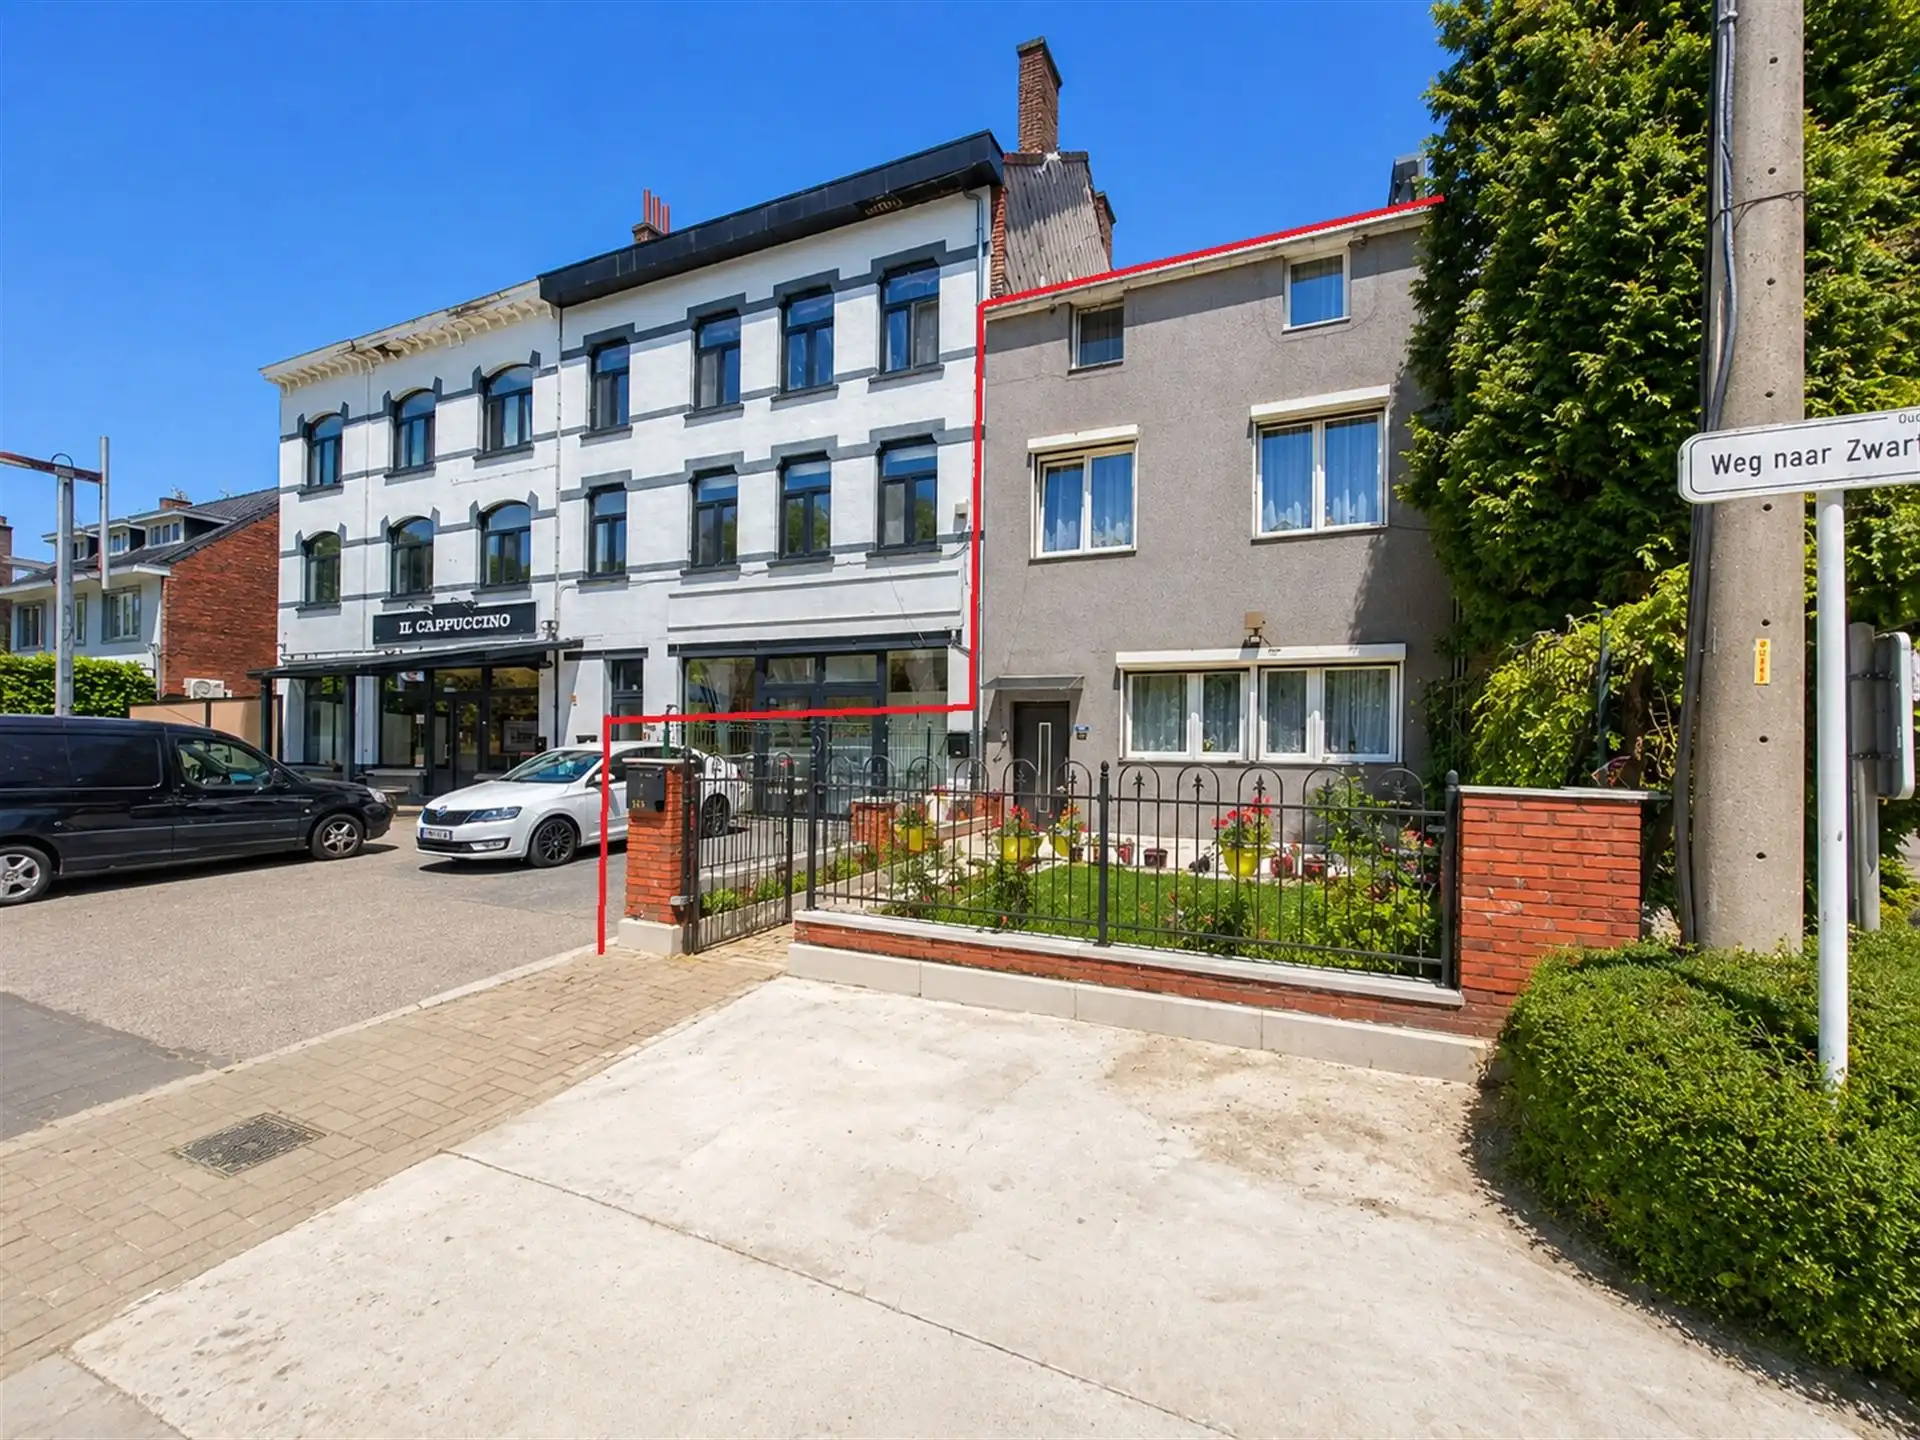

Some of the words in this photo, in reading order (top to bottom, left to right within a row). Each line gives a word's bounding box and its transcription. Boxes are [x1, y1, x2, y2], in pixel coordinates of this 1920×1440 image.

[1711, 453, 1762, 477] Weg
[1774, 447, 1832, 469] naar
[399, 621, 412, 634] IL
[416, 614, 510, 633] CAPPUCCINO
